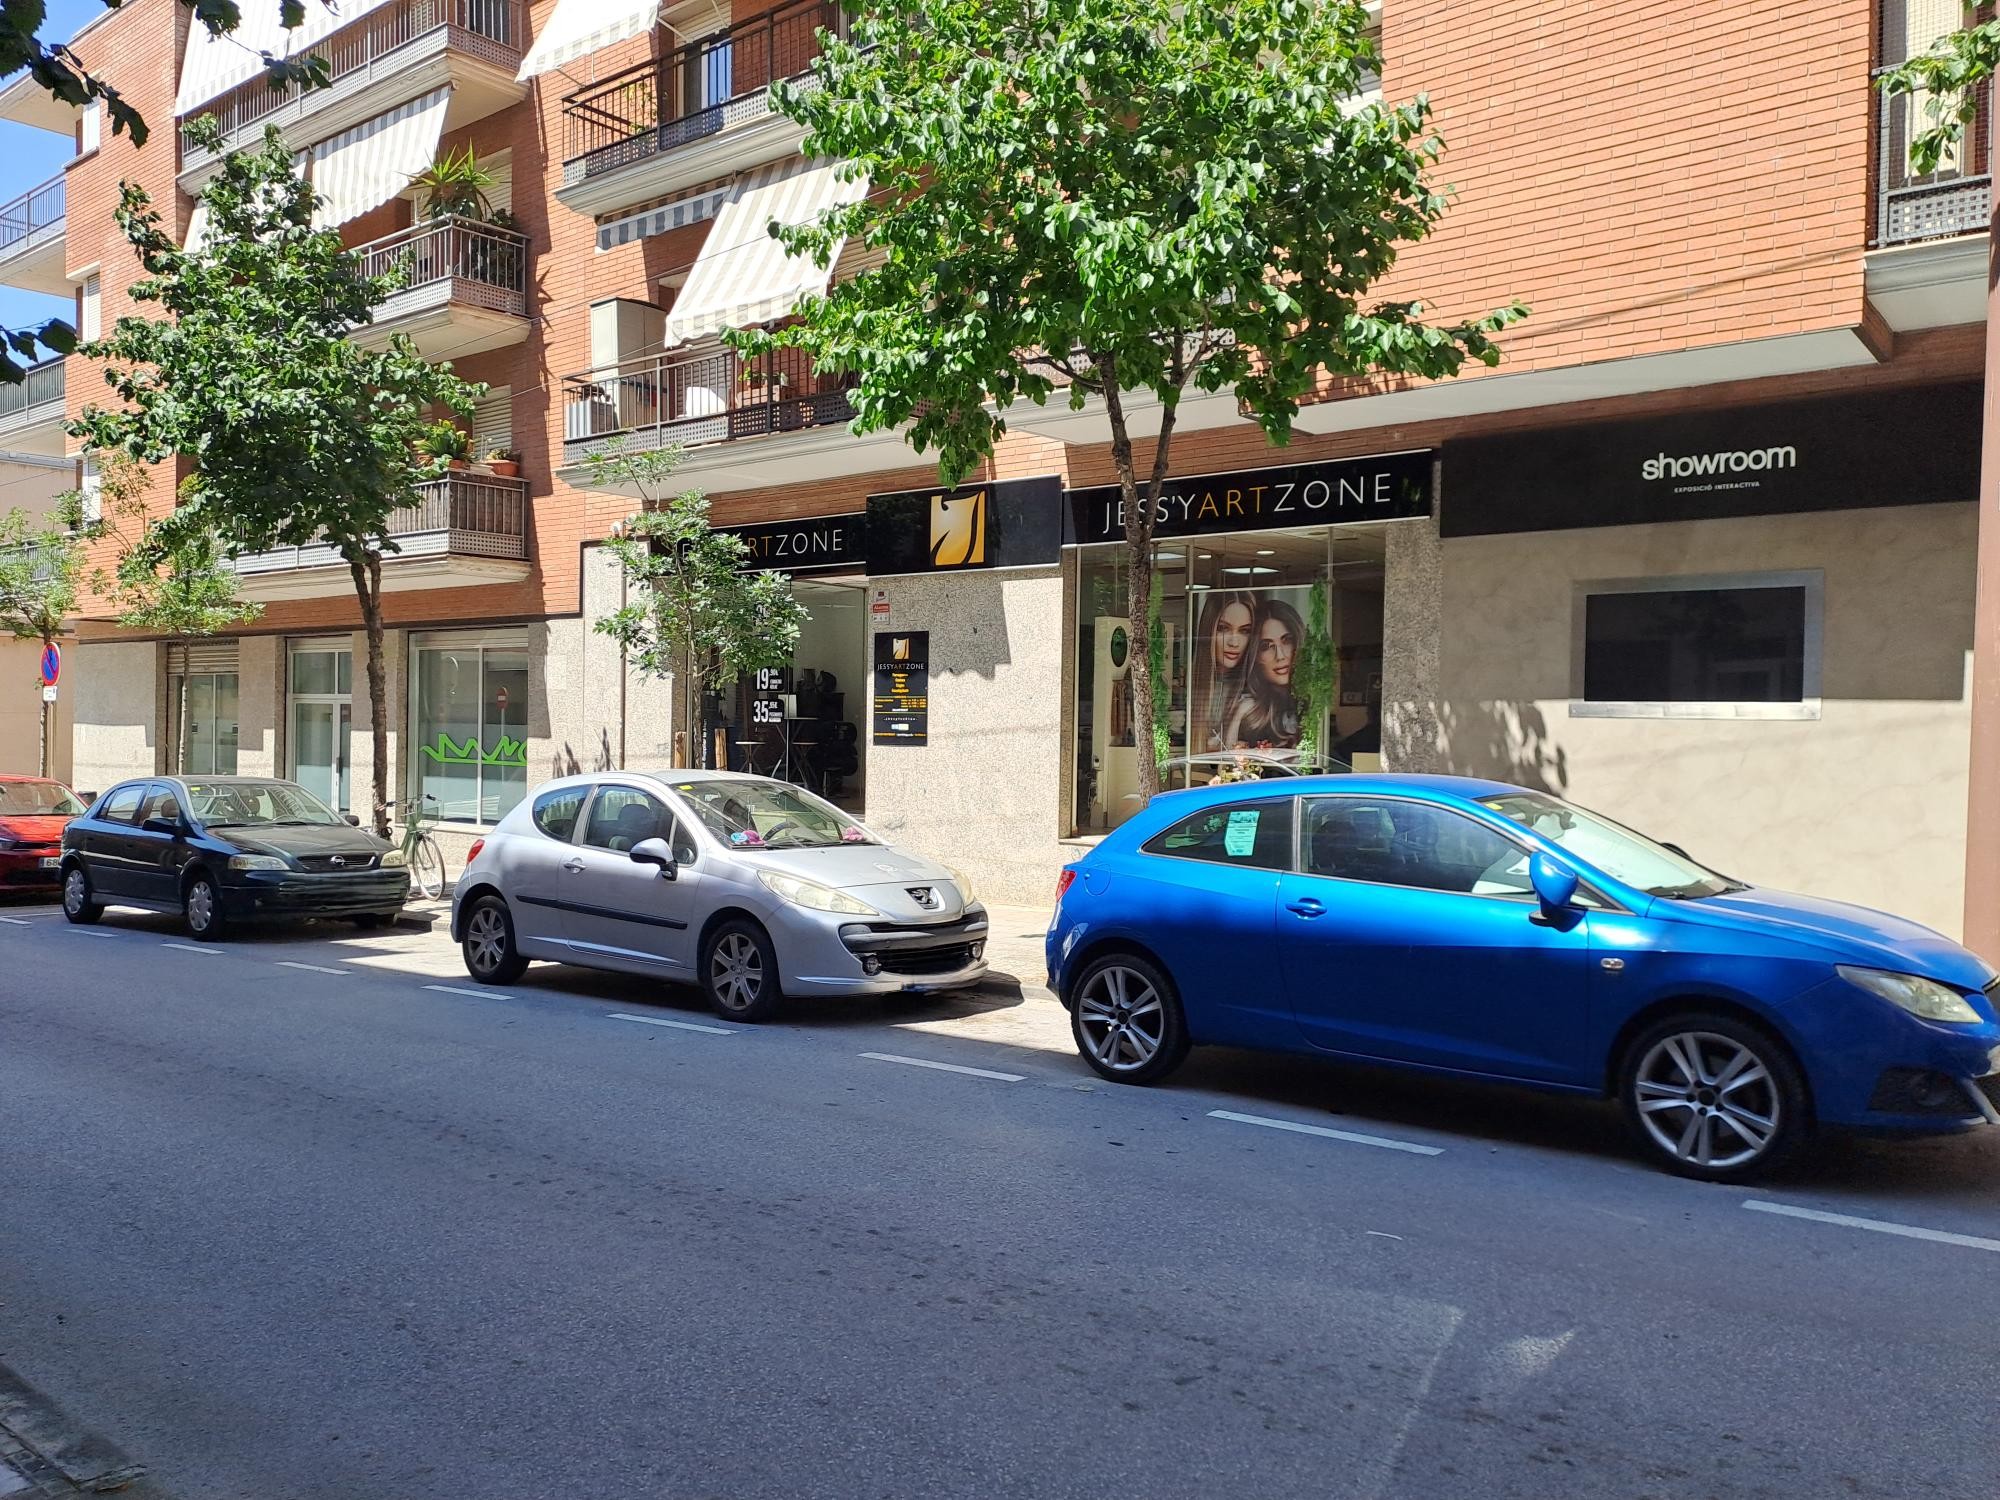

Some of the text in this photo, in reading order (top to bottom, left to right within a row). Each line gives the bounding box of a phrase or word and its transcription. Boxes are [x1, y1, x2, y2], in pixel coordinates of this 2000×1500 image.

[1642, 446, 1796, 480] showroom
[1674, 481, 1760, 494] EXPOSICIÓ INTERACTIVA
